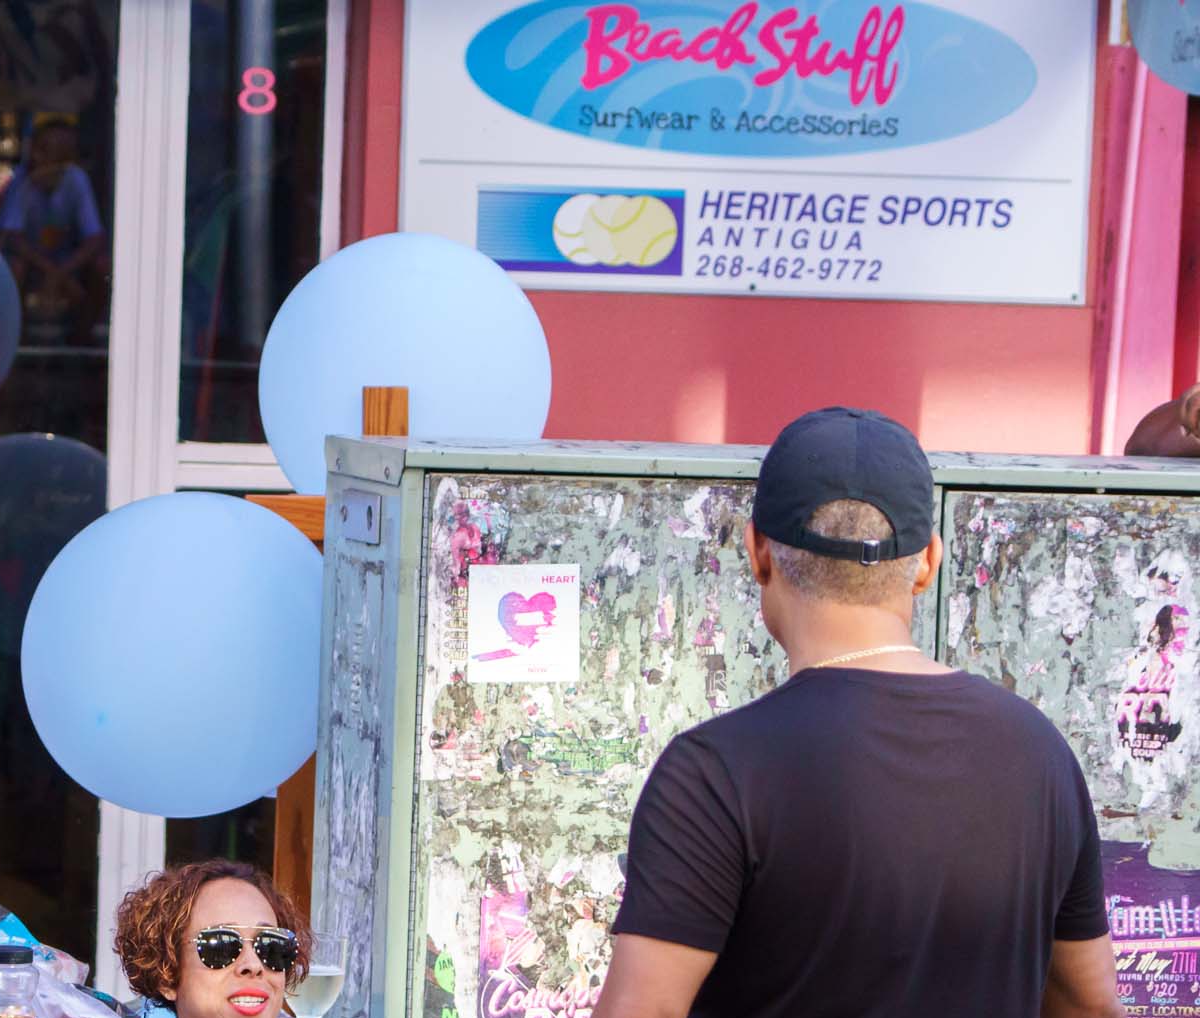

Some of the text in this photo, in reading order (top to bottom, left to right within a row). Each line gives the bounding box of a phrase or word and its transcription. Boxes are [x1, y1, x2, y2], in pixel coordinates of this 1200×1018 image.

[580, 2, 905, 107] Beach Stuff
[237, 66, 277, 115] 8
[578, 104, 900, 138] Surfwear & Accessories
[698, 189, 1014, 229] HERITAGE SPORTS
[696, 226, 863, 252] ANTIGUA
[695, 254, 883, 282] 268-462-9772
[541, 575, 576, 584] HEART
[1171, 951, 1197, 974] 27TH
